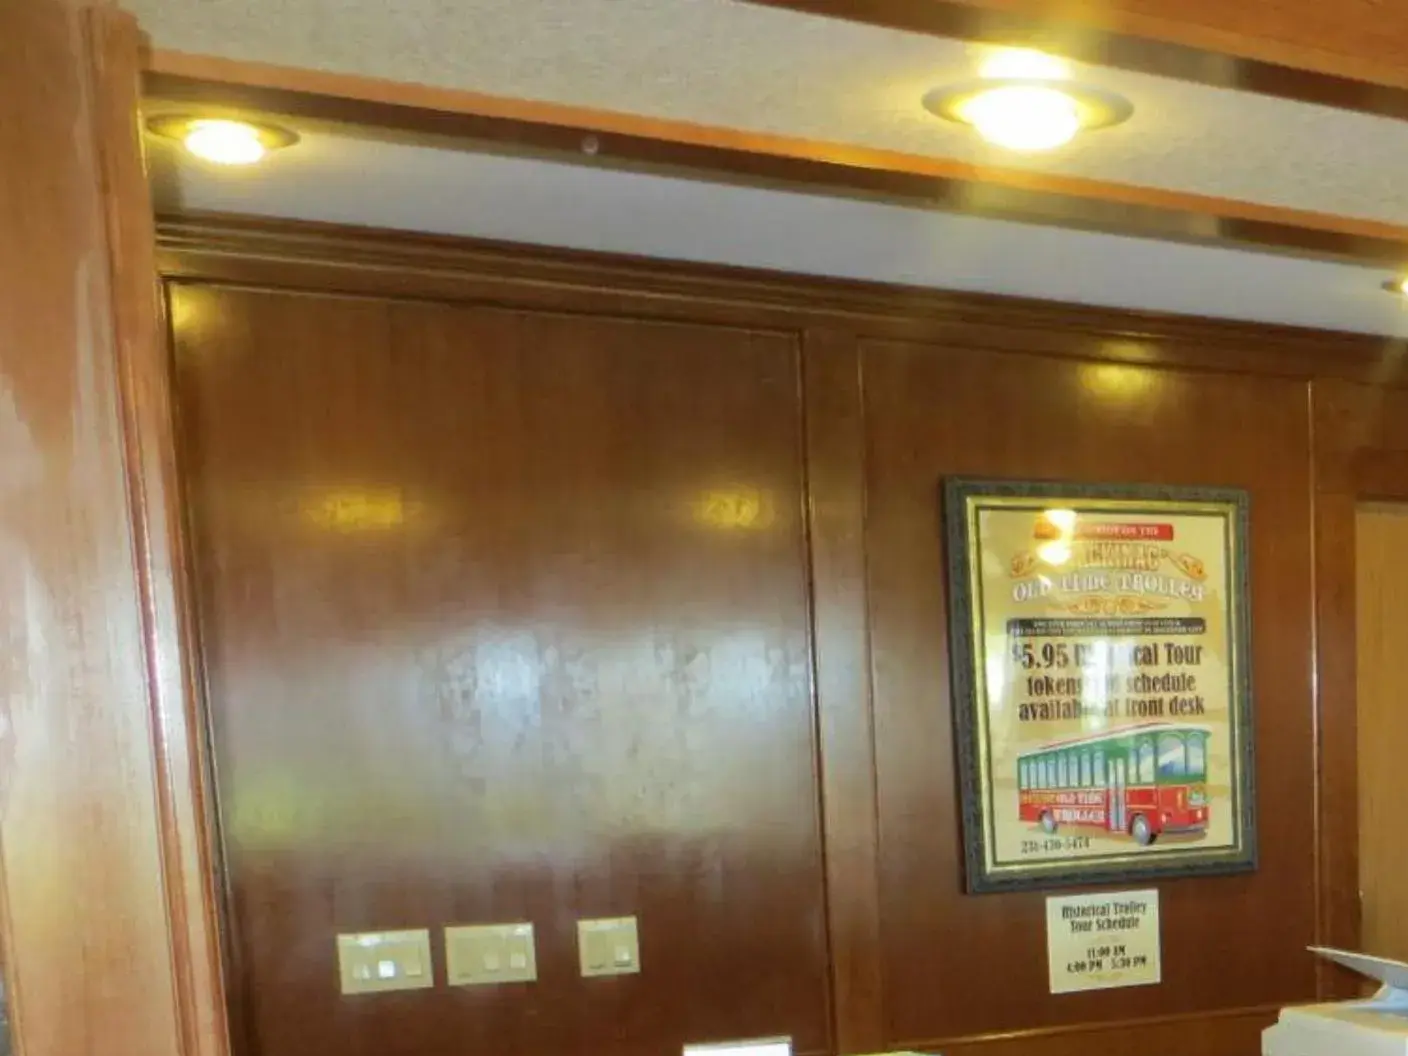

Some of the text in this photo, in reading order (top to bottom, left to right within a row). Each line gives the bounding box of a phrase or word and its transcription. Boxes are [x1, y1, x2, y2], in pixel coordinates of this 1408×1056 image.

[1164, 642, 1203, 666] Tour
[1126, 672, 1196, 693] schedule
[1126, 697, 1163, 718] front
[1169, 696, 1205, 716] desk
[1096, 917, 1140, 931] Schedule
